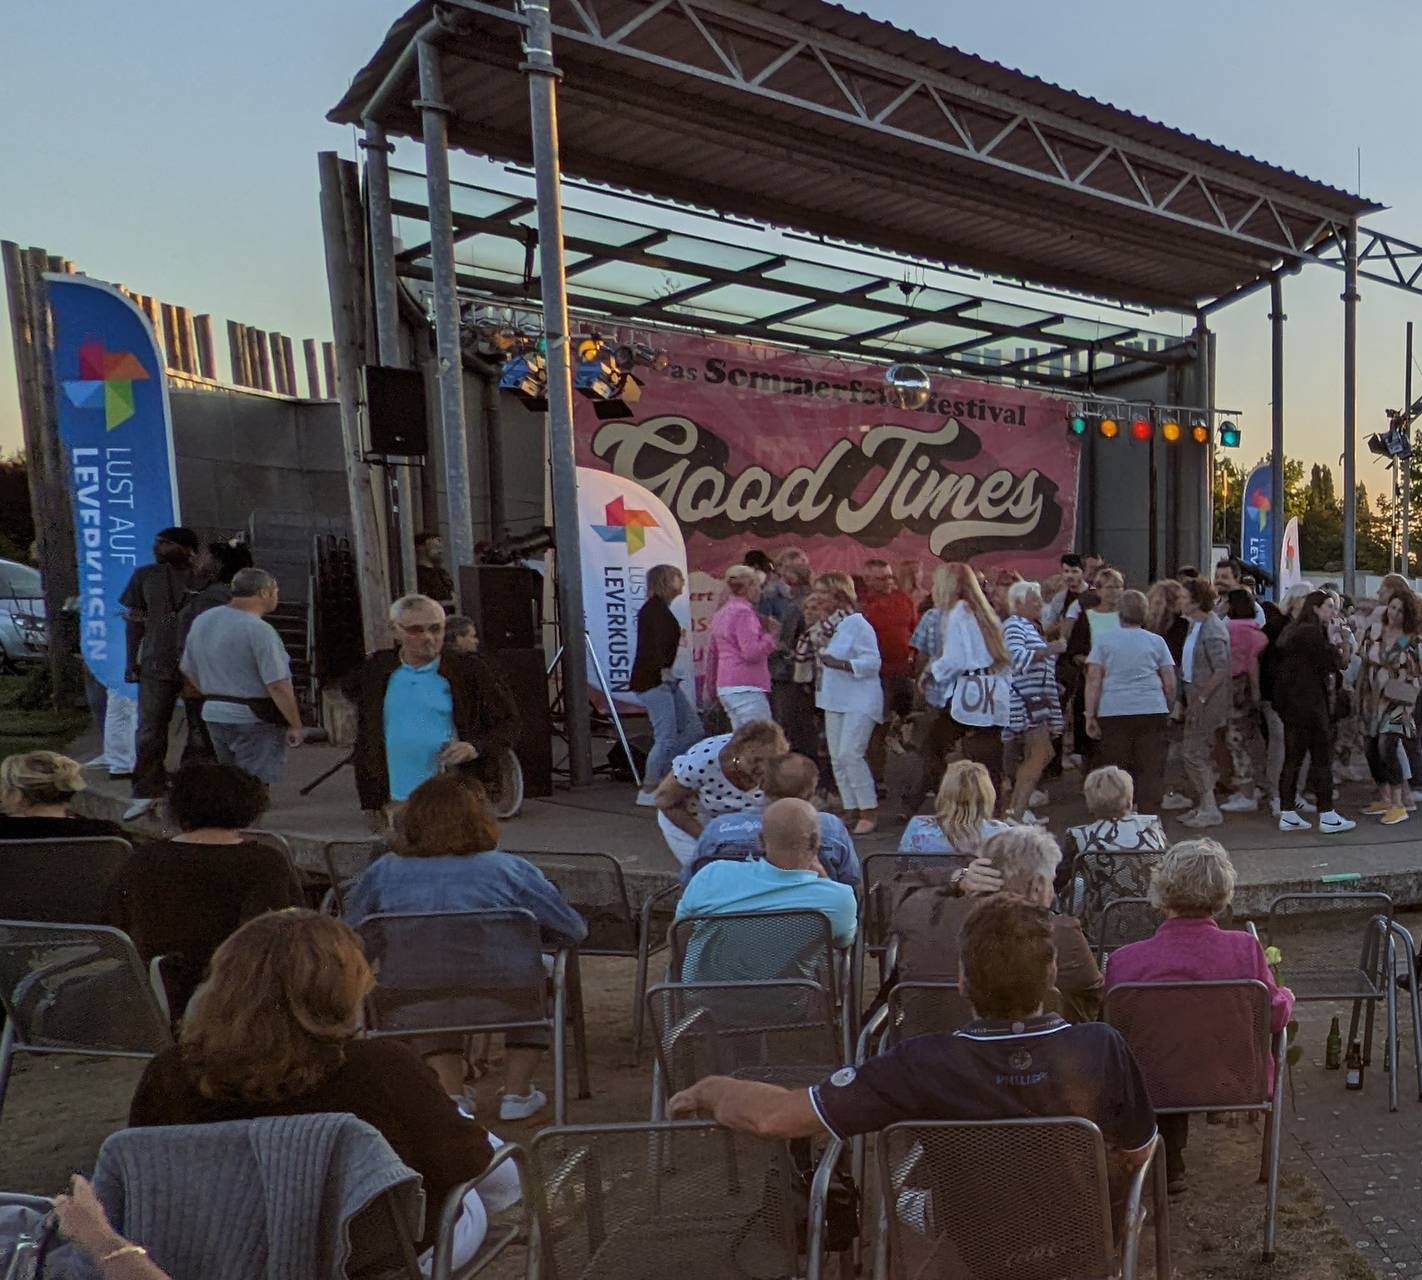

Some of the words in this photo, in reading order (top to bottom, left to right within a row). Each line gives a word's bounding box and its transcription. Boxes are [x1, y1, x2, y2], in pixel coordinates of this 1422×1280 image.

[669, 363, 698, 381] as
[106, 448, 134, 509] LUST
[592, 416, 852, 522] Good
[836, 418, 1044, 557] Times
[108, 516, 136, 566] AUF
[604, 566, 630, 693] LEVERKUSEN
